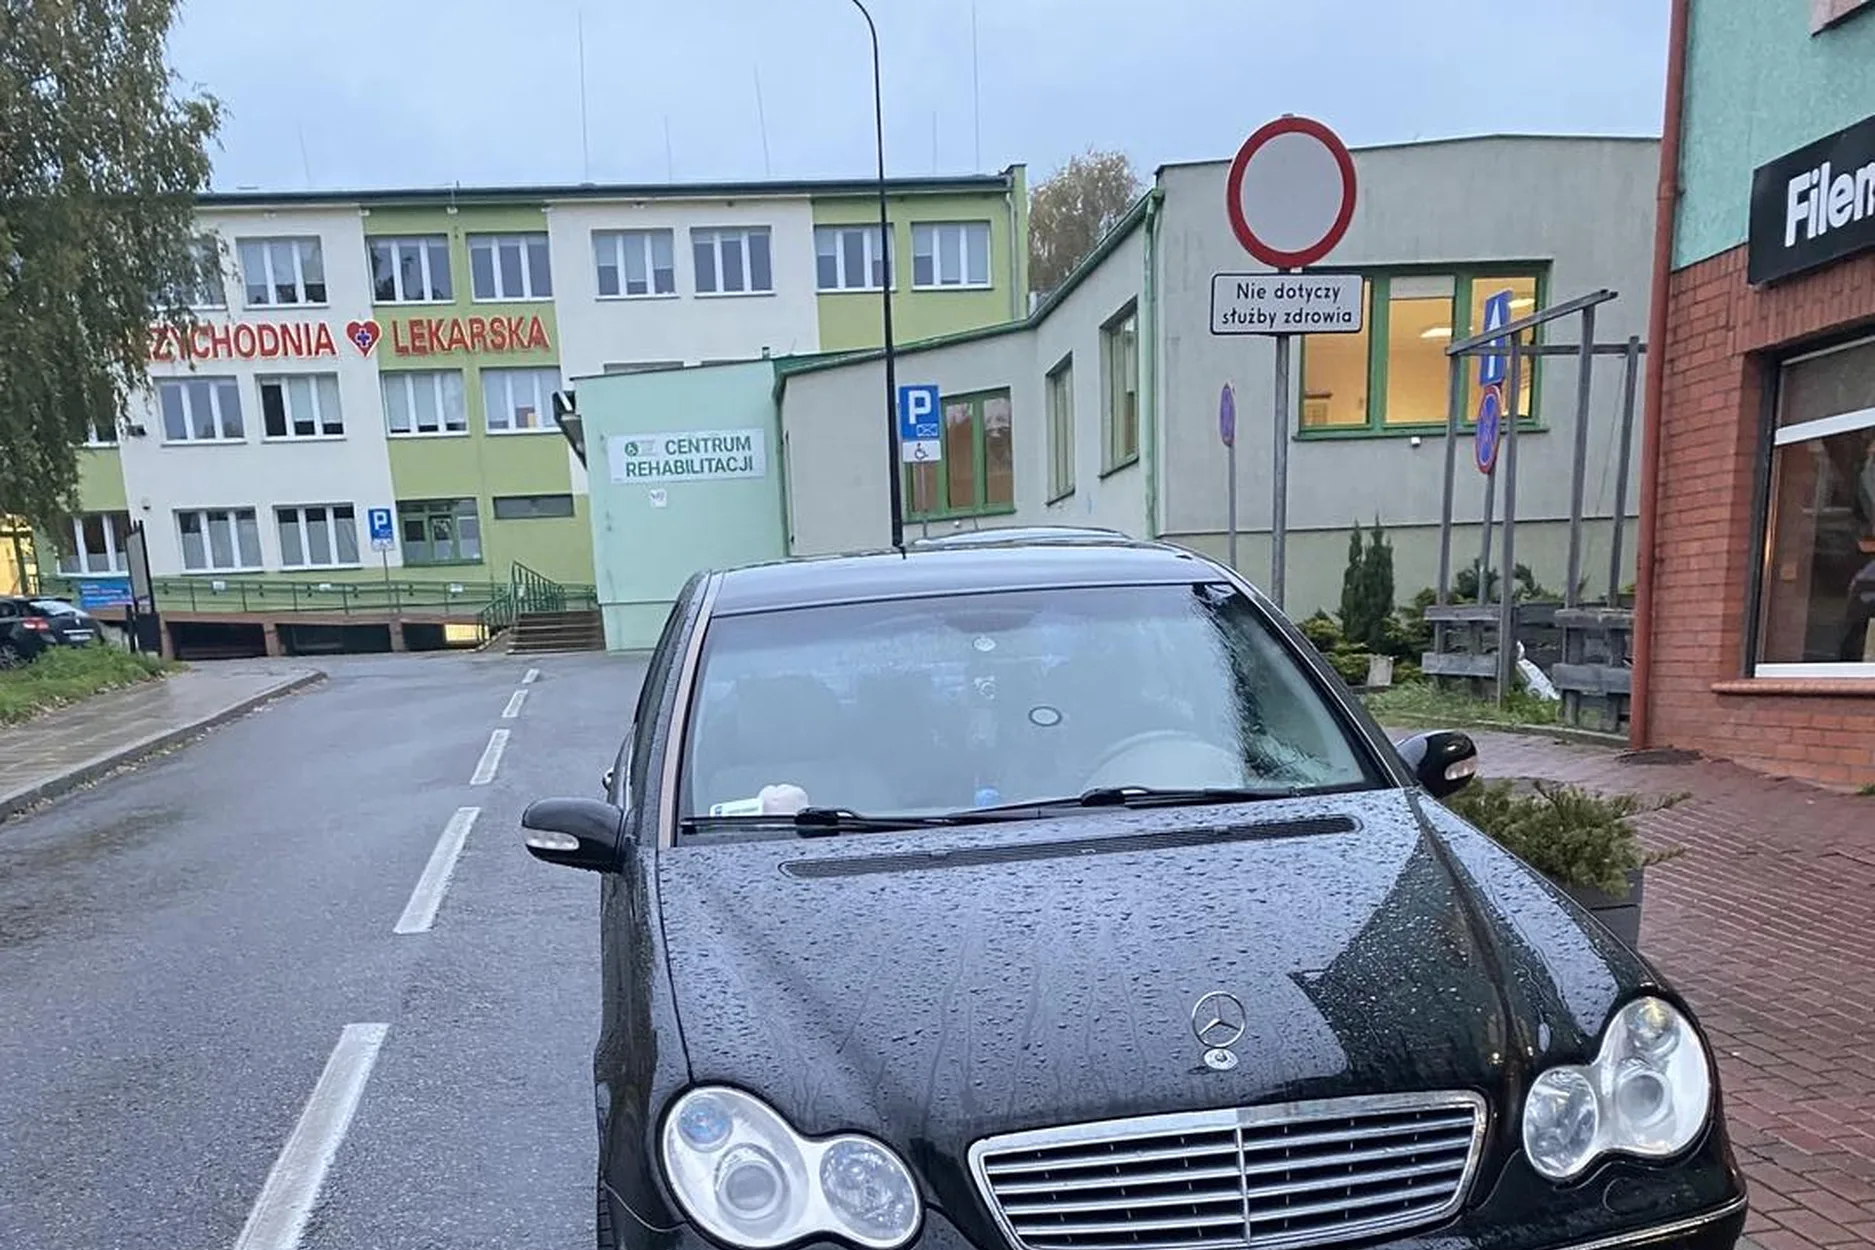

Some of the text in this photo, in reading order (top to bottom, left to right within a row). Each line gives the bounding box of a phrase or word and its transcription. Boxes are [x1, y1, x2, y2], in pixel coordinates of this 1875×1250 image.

[1237, 282, 1341, 303] Nie dotyczy
[1222, 306, 1352, 328] służby zdrowia
[392, 315, 549, 357] LEKARSKA
[909, 390, 931, 424] P
[665, 436, 751, 455] CENTRUM
[626, 455, 753, 477] REHABILITACJI
[373, 511, 387, 530] P
